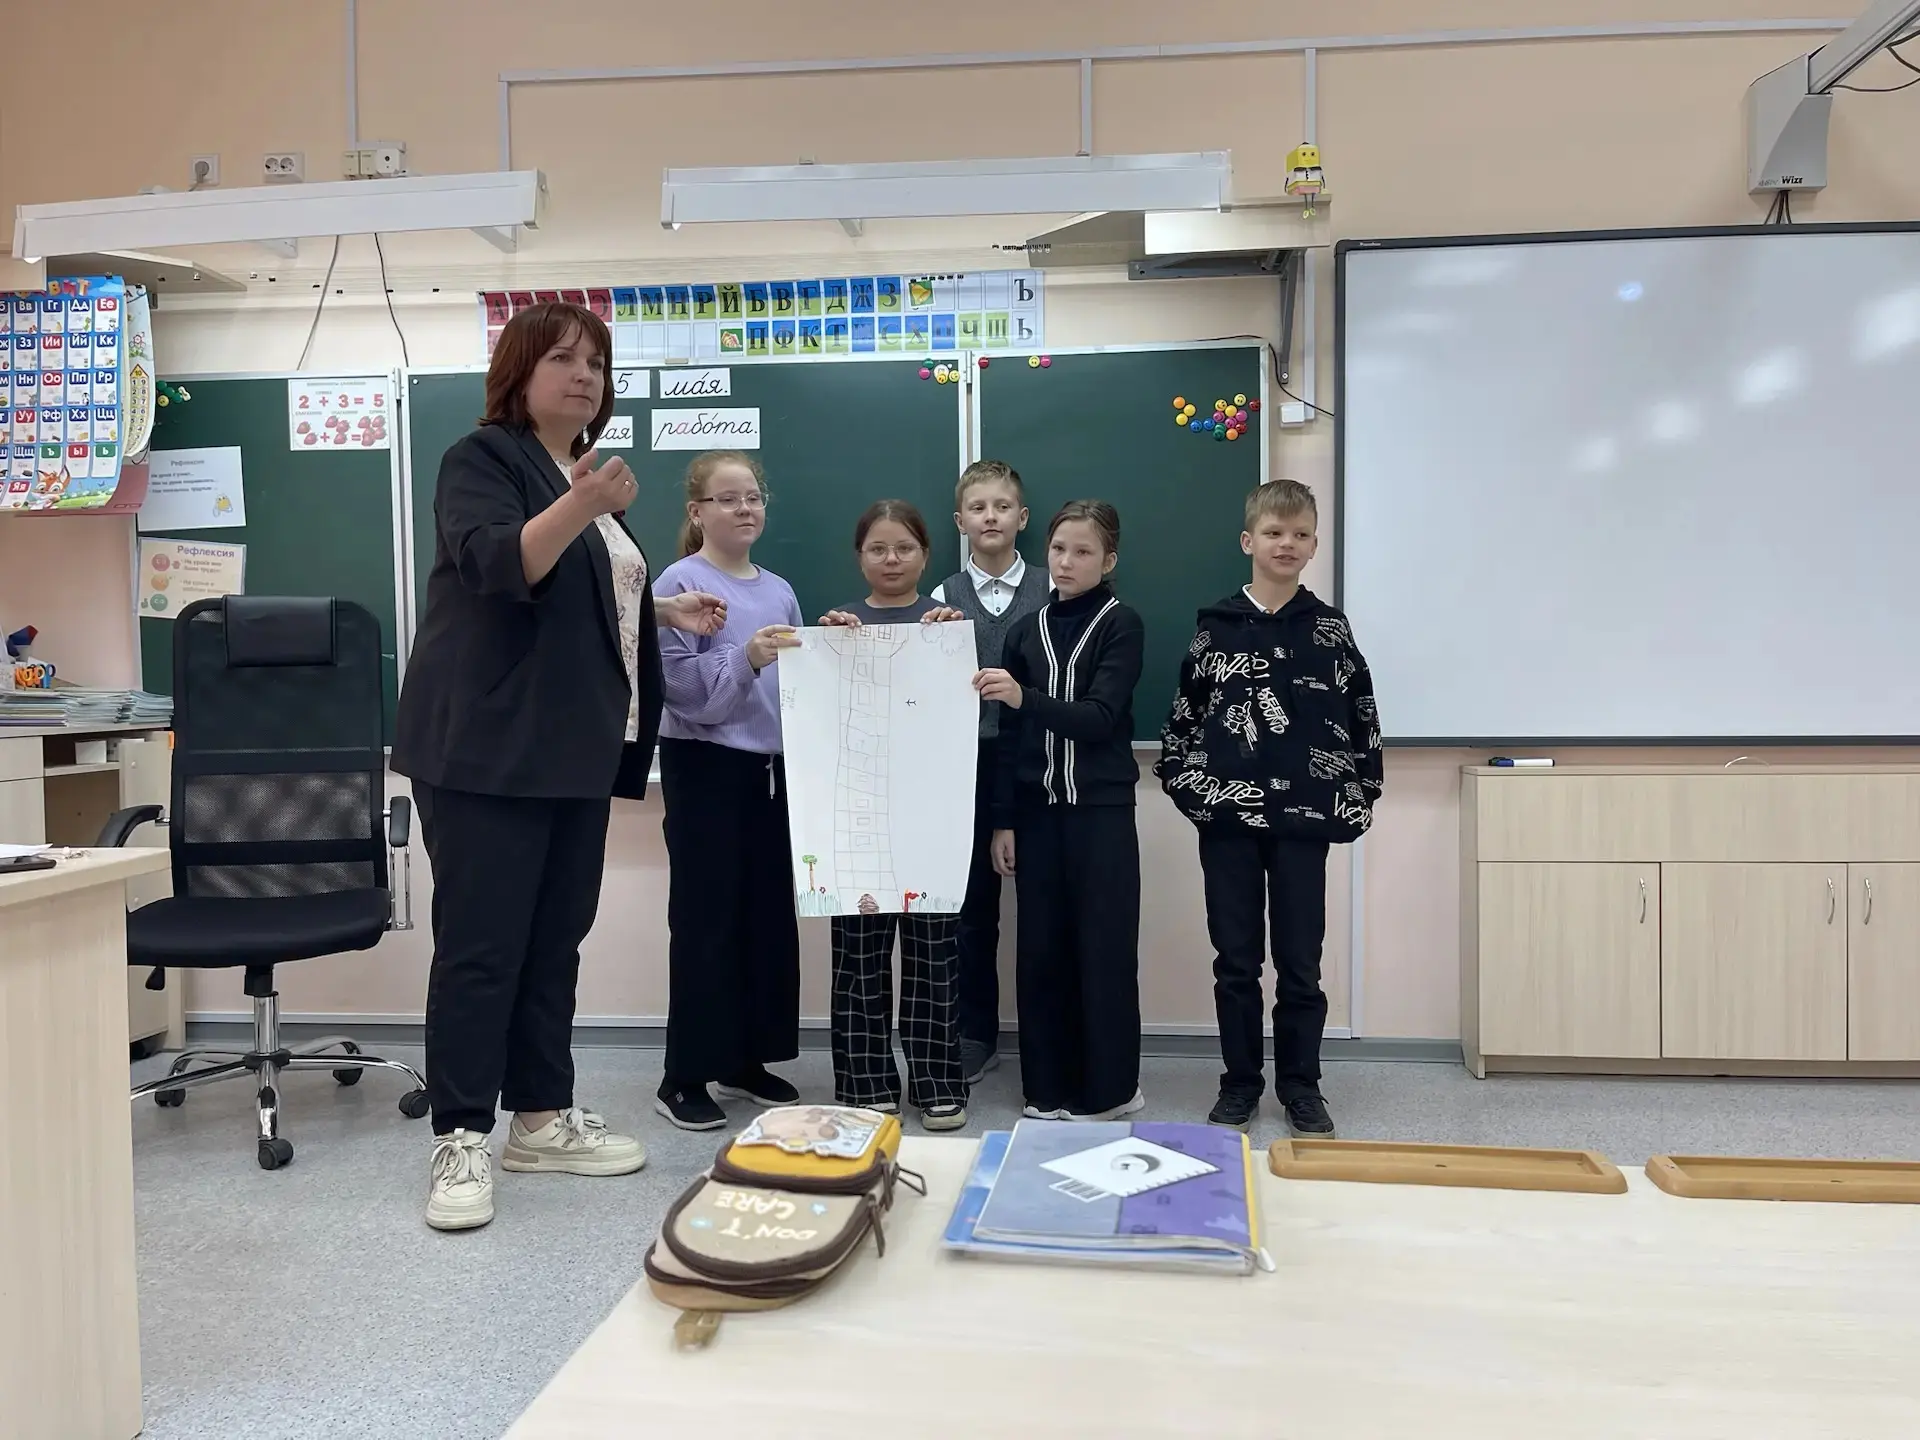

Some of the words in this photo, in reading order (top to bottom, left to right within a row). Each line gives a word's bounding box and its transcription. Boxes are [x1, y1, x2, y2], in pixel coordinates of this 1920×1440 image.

[617, 293, 636, 316] Л
[641, 292, 662, 315] М
[669, 291, 688, 314] Н
[696, 291, 713, 314] Р
[721, 285, 740, 313] Й
[750, 289, 765, 312] Б
[775, 288, 791, 311] В
[801, 286, 816, 310] Г
[826, 285, 845, 313] Д
[852, 284, 872, 308] Ж
[882, 282, 897, 307] З
[1014, 279, 1034, 301] Ъ
[20, 302, 32, 311] Вв
[48, 301, 58, 310] Гг
[70, 300, 89, 311] Дд
[100, 299, 114, 309] Ее
[749, 328, 766, 349] П
[774, 328, 794, 348] Ф
[802, 325, 819, 347] К
[827, 324, 845, 346] Т
[962, 320, 978, 341] Ч
[988, 319, 1008, 345] Щ
[1016, 318, 1033, 340] Ь
[20, 337, 32, 347] Зз
[45, 337, 60, 346] Ии
[72, 334, 87, 346] Йй
[100, 335, 114, 345] Кк
[19, 374, 34, 384] Нн
[44, 374, 60, 384] Оо
[71, 371, 87, 383] Пп
[98, 371, 112, 384] Рр
[298, 395, 309, 409] 2
[338, 394, 349, 408] 3
[373, 394, 384, 407] 5
[18, 411, 33, 421] Уу
[42, 410, 61, 421] Фф
[71, 408, 87, 420] Хх
[97, 407, 115, 419] Цц
[14, 446, 35, 458] Щщ
[12, 482, 26, 491] Яя
[177, 545, 235, 558] Рефлексия
[713, 1190, 797, 1220] CARE
[718, 1217, 818, 1240] DON'T
